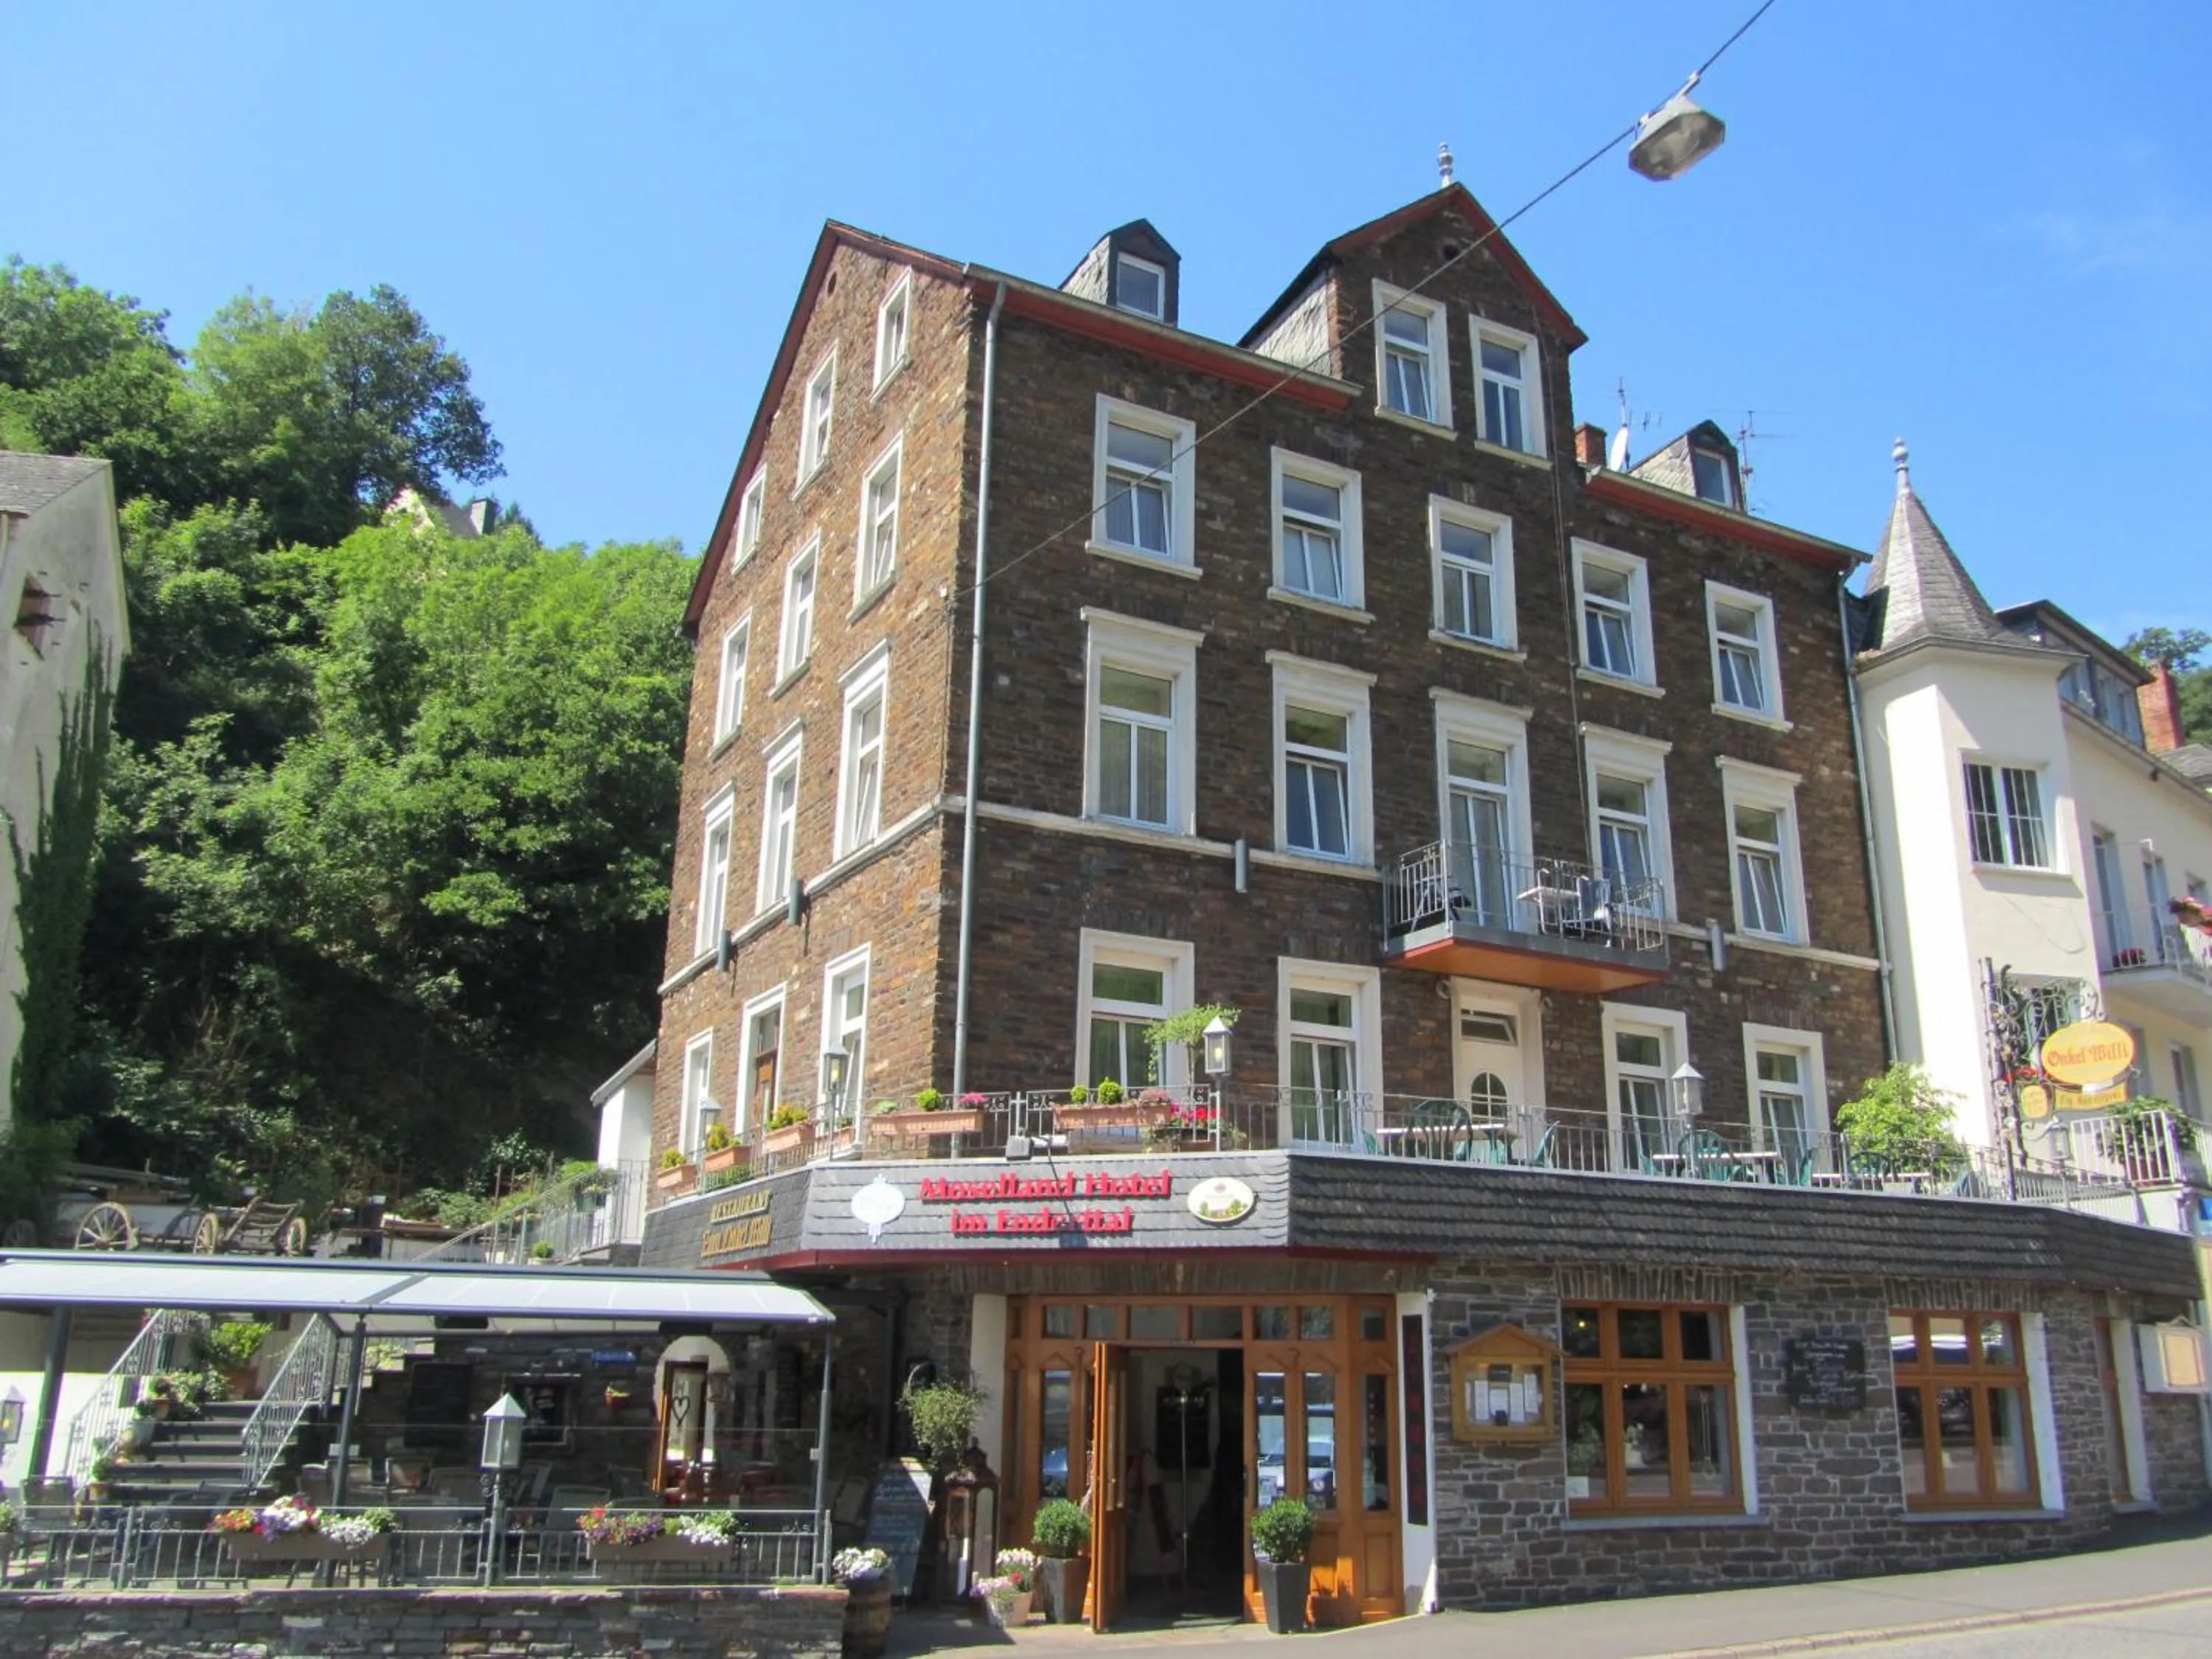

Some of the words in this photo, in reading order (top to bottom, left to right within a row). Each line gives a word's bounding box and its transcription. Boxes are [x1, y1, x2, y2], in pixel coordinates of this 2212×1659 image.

[2048, 1046, 2086, 1066] Onkel
[2088, 1042, 2129, 1062] Willi
[920, 1170, 1077, 1202] Moselland
[1085, 1168, 1173, 1199] Hotel
[950, 1208, 989, 1235] im
[996, 1206, 1133, 1234] Enderttal
